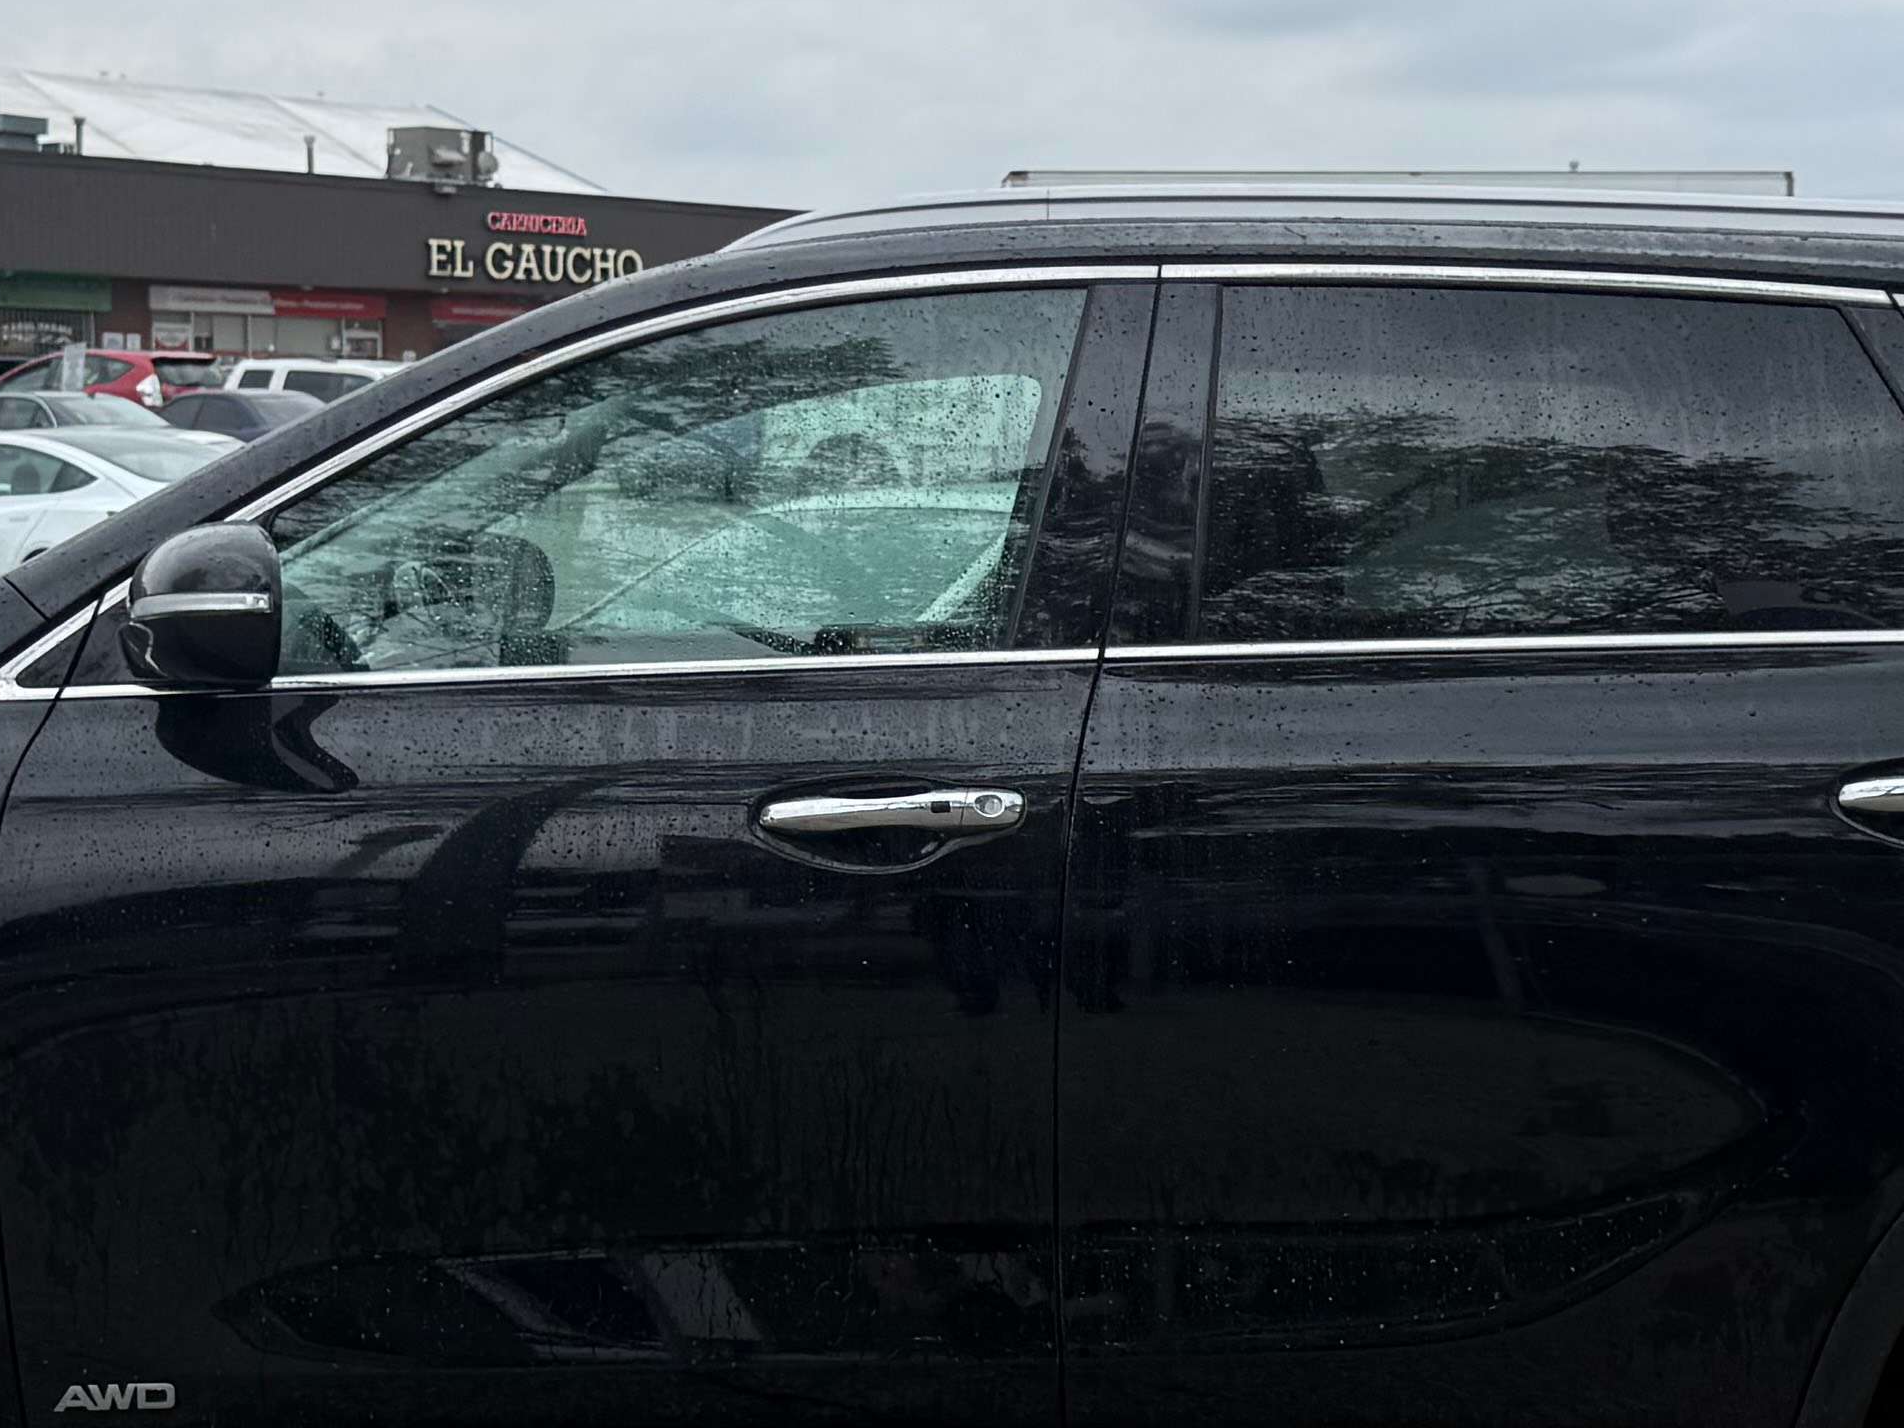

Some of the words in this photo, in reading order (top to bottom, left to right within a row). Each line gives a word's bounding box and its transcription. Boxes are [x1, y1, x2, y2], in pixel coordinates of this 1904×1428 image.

[428, 238, 474, 278] EL
[484, 241, 646, 284] GAUCHO
[53, 1382, 176, 1413] AWD
